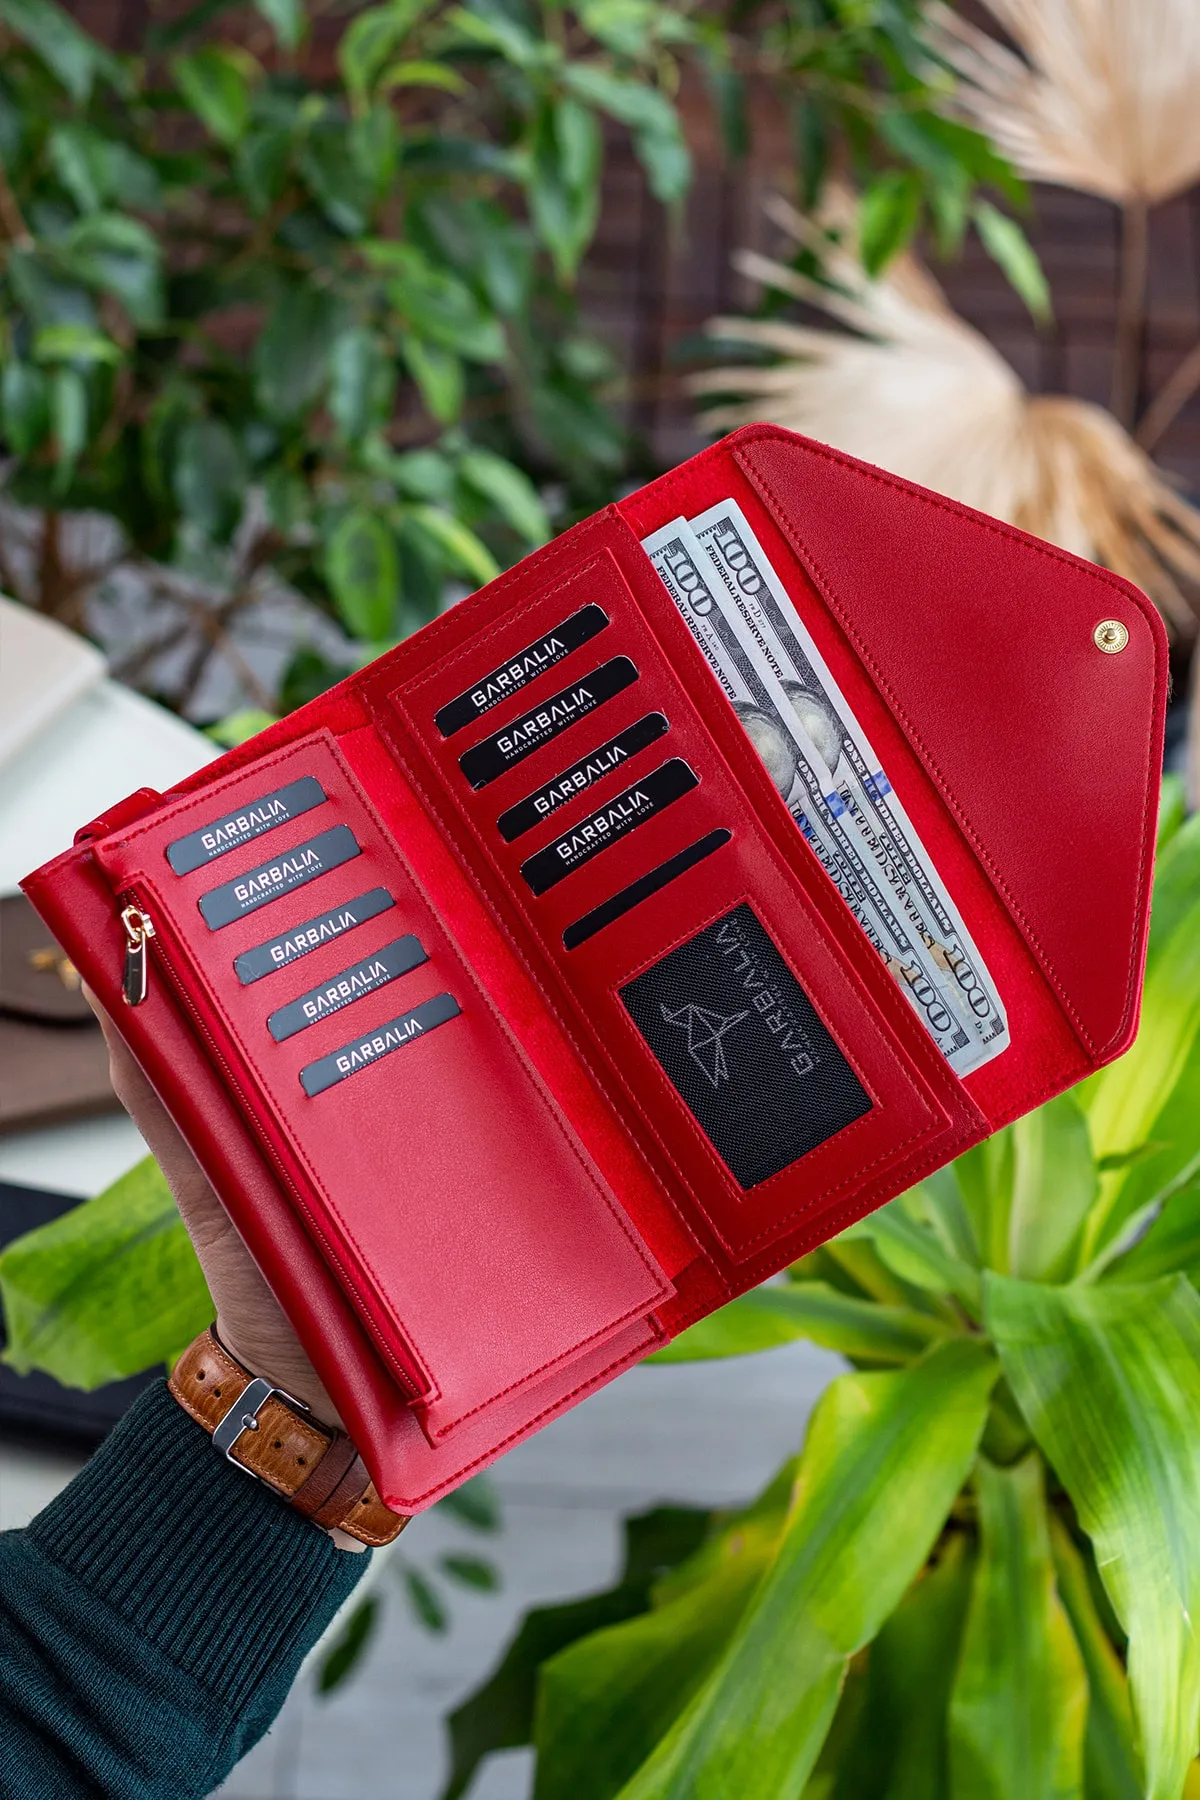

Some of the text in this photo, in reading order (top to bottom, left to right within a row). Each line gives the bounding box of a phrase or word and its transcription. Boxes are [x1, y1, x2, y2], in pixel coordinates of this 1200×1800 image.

[663, 550, 713, 617] 100
[713, 530, 761, 596] 100
[656, 566, 737, 700] FEDERAL RESERVE NOTE
[705, 544, 784, 679] FEDERAL RESERVE NOTE
[471, 637, 565, 707] GARBALIA
[479, 648, 569, 714] HANDCRAFTED WITH LOVE
[497, 688, 593, 753] GARBALIA
[505, 699, 598, 760] HANDCRAFTED WITH LOVE
[533, 746, 628, 814] GARBALIA
[201, 800, 287, 850] GARBALIA
[208, 812, 290, 857] HANDCRAFTED WITH LOVE
[556, 791, 650, 859] GARBALIA
[565, 802, 655, 866] HANDCRAFTED WITH LOVE
[234, 849, 319, 901] GARBALIA
[241, 862, 323, 909] HANDCRAFTED WITH LOVE
[270, 912, 357, 963] GARBALIA
[303, 961, 388, 1018] GARBALIA
[356, 987, 372, 1000] WITH
[375, 974, 391, 986] LOVE
[716, 924, 815, 1076] GARBALIA
[900, 960, 951, 1032] 100
[943, 944, 990, 1018] 100
[336, 1019, 423, 1073] GARBALIA
